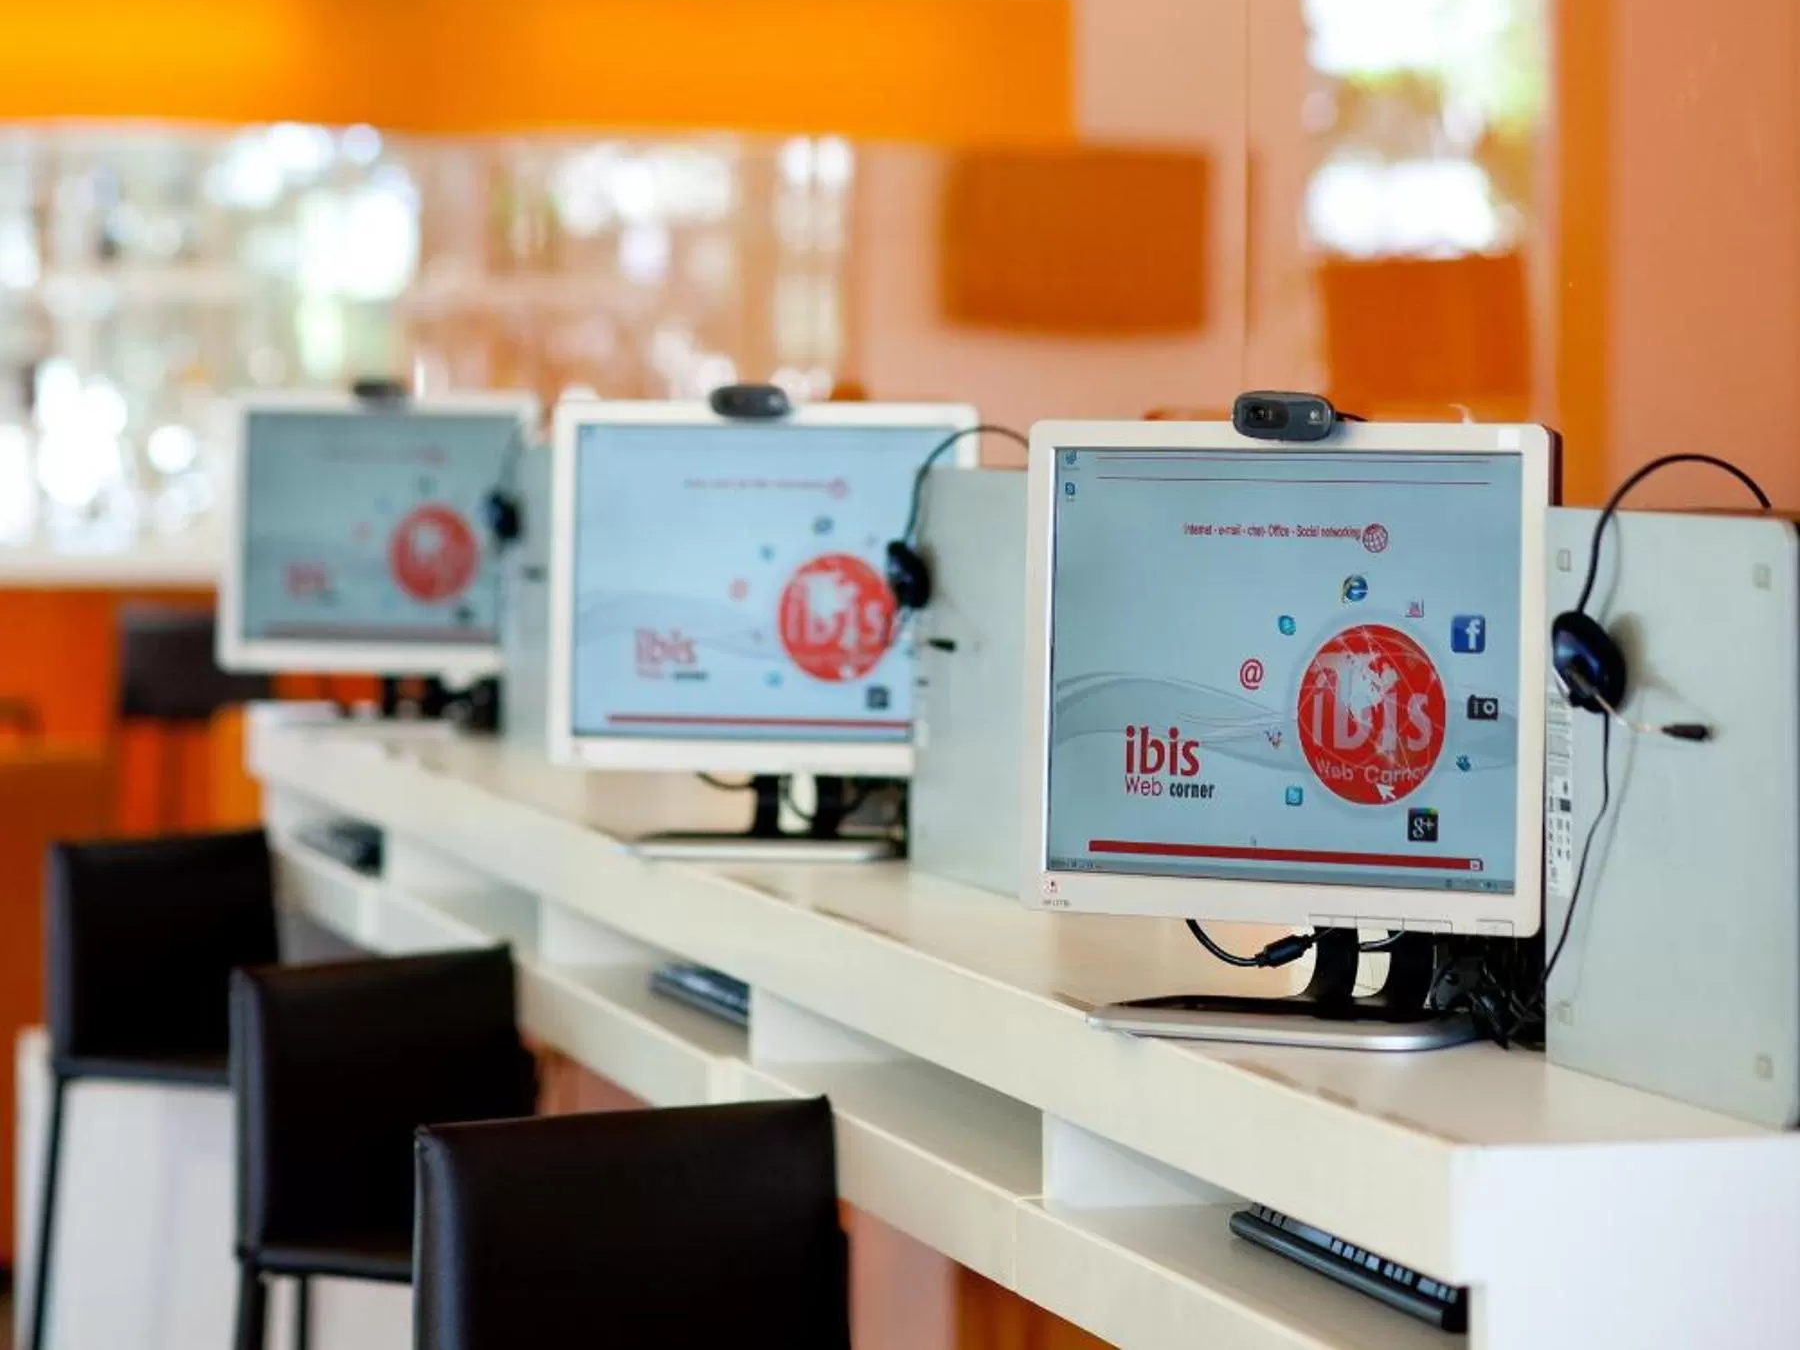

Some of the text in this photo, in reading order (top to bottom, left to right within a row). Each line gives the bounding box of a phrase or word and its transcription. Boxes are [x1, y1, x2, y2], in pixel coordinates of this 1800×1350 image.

[1311, 653, 1433, 751] ibis
[1125, 725, 1200, 777] ibis
[1124, 775, 1216, 799] Web corner
